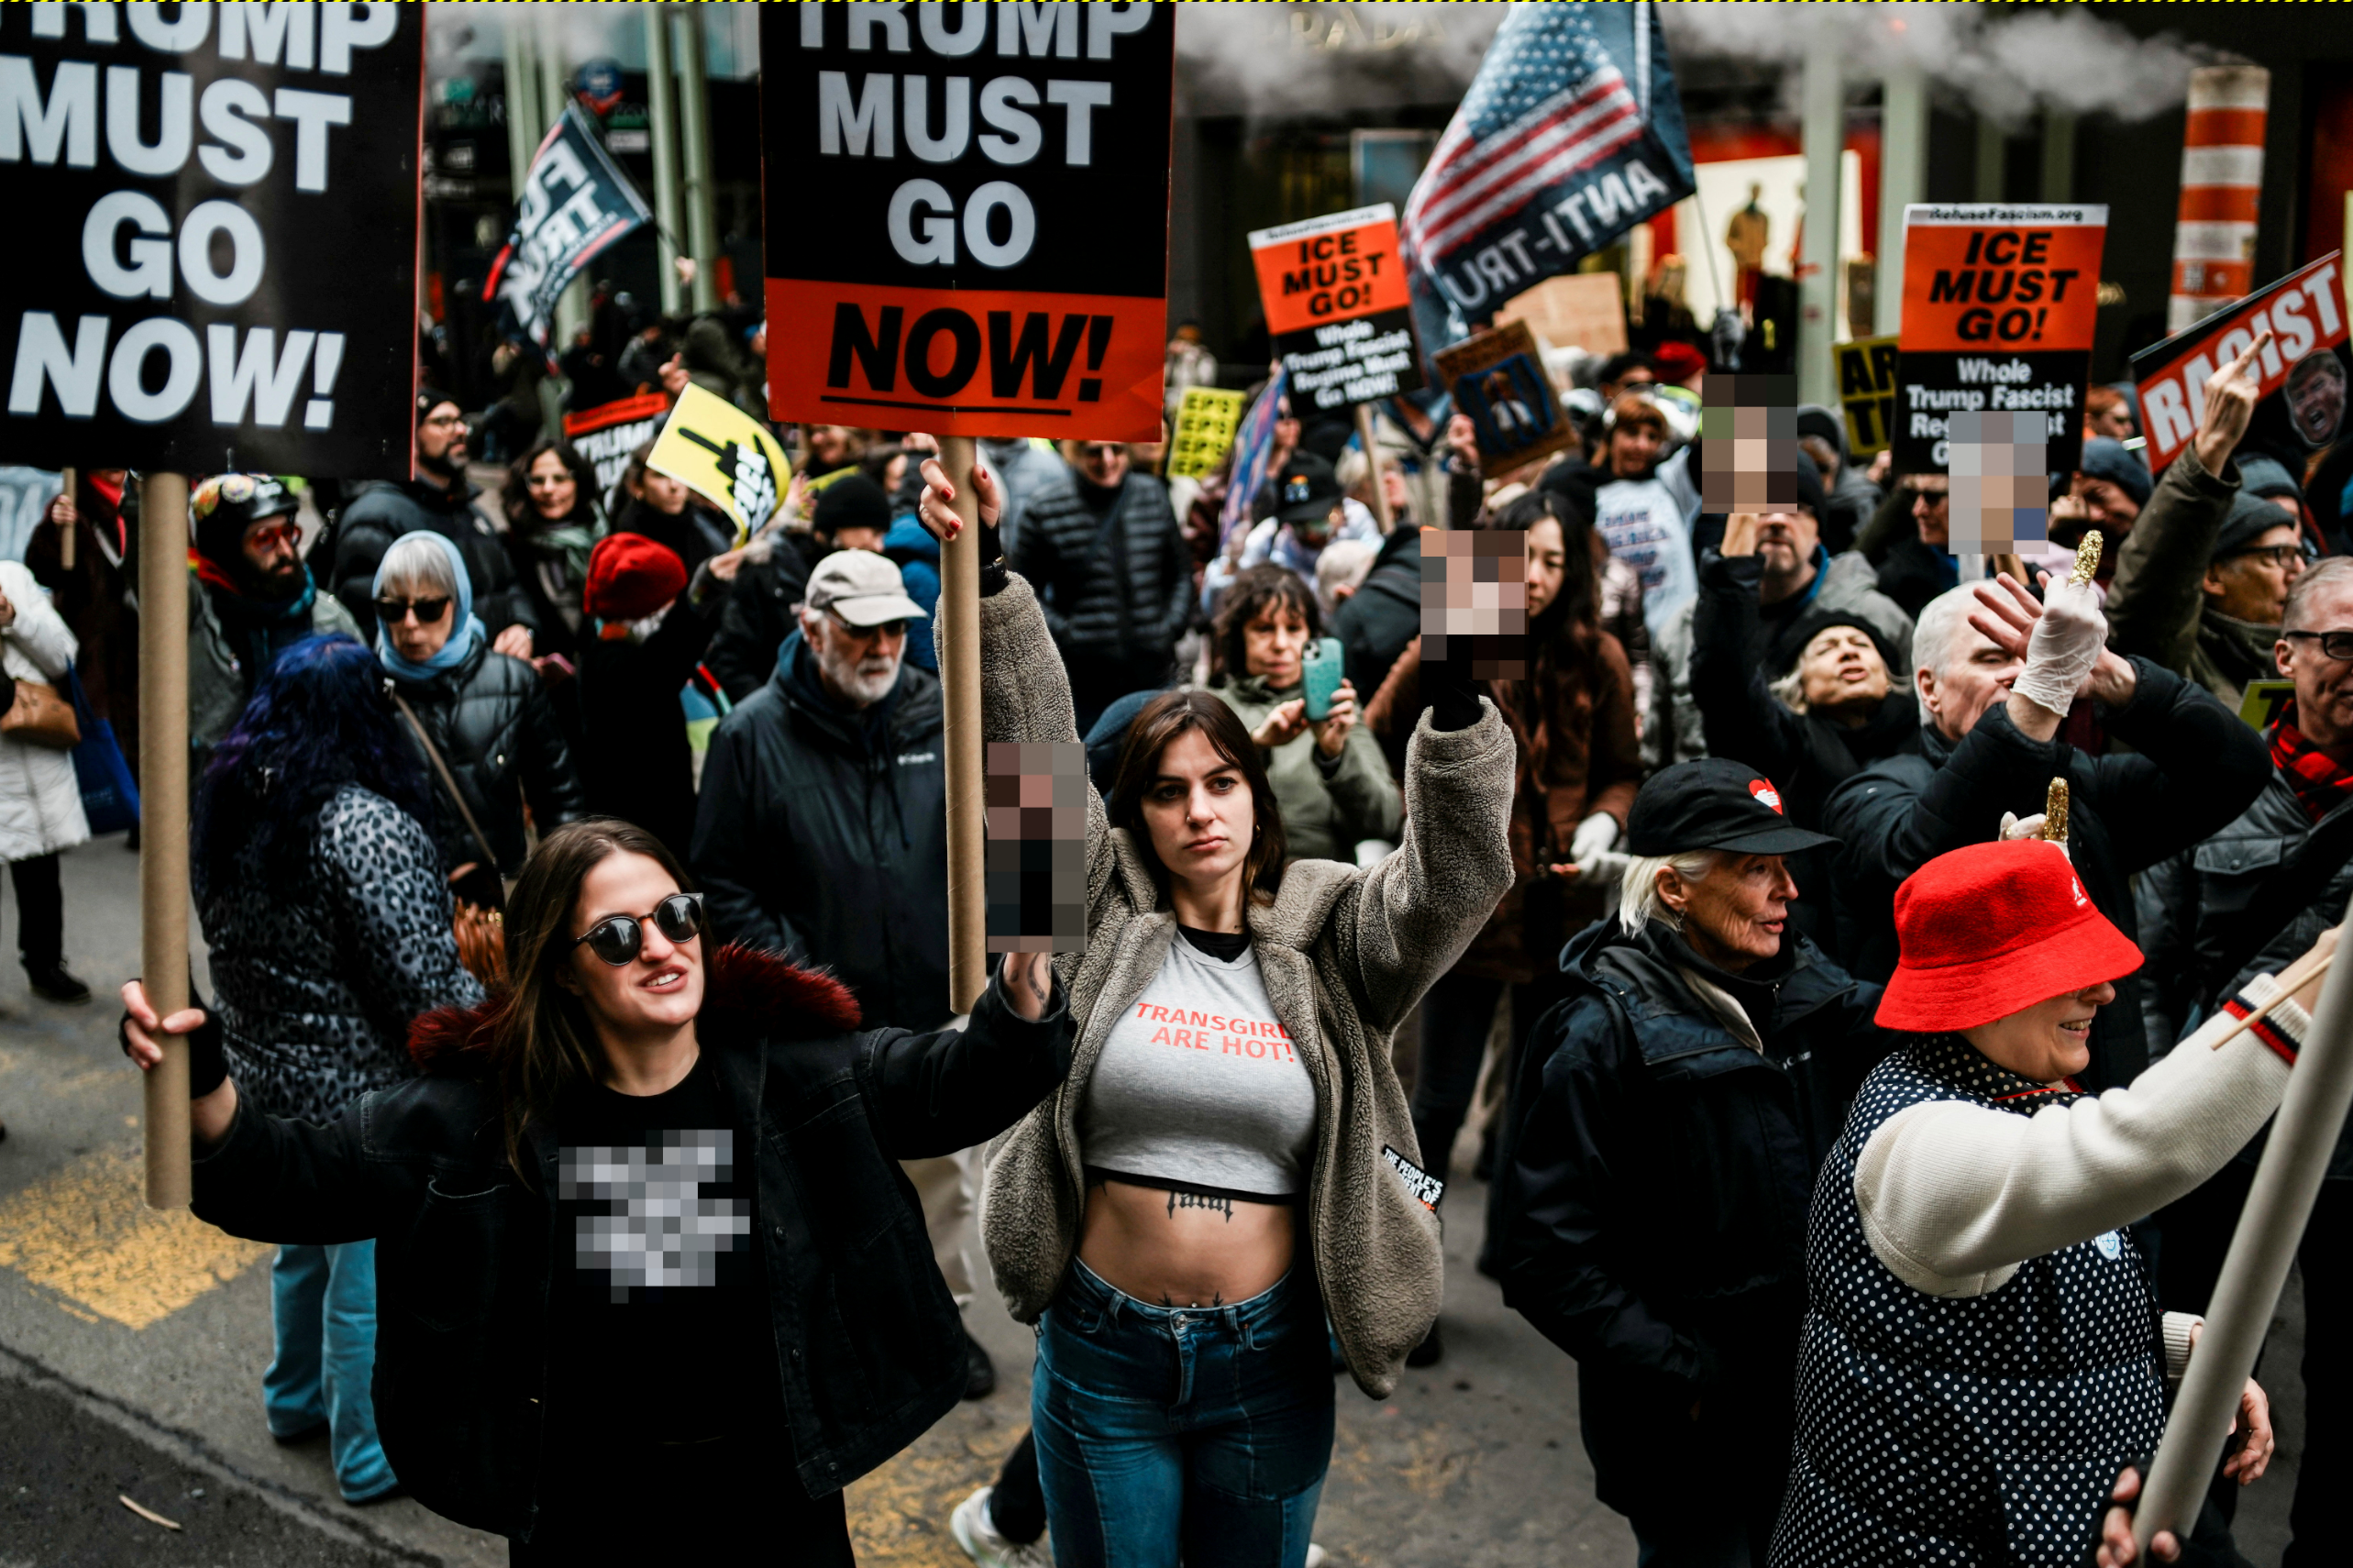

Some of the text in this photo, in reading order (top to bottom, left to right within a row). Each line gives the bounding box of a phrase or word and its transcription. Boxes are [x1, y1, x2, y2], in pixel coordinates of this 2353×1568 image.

[0, 54, 353, 193] MUST
[819, 71, 1111, 166] MUST
[888, 178, 1036, 268] GO
[82, 190, 266, 305] GO
[1299, 230, 1357, 264] ICE
[1964, 232, 2052, 265] ICE
[1282, 252, 1385, 296] MUST
[1928, 270, 2079, 304] MUST
[1309, 282, 1373, 316] GO!
[1314, 319, 1375, 348] Whole
[1957, 307, 2049, 342] GO!
[7, 311, 346, 431] NOW!
[826, 303, 1113, 403] NOW!
[1957, 358, 2032, 383] Whole
[1906, 382, 2075, 411] Trump Fascist
[1136, 1002, 1295, 1041] TRANSGIRL
[1150, 1026, 1295, 1063] ARE HOT!
[1384, 1148, 1444, 1196] THE PEOPLE'S
[1421, 1189, 1440, 1205] OF
